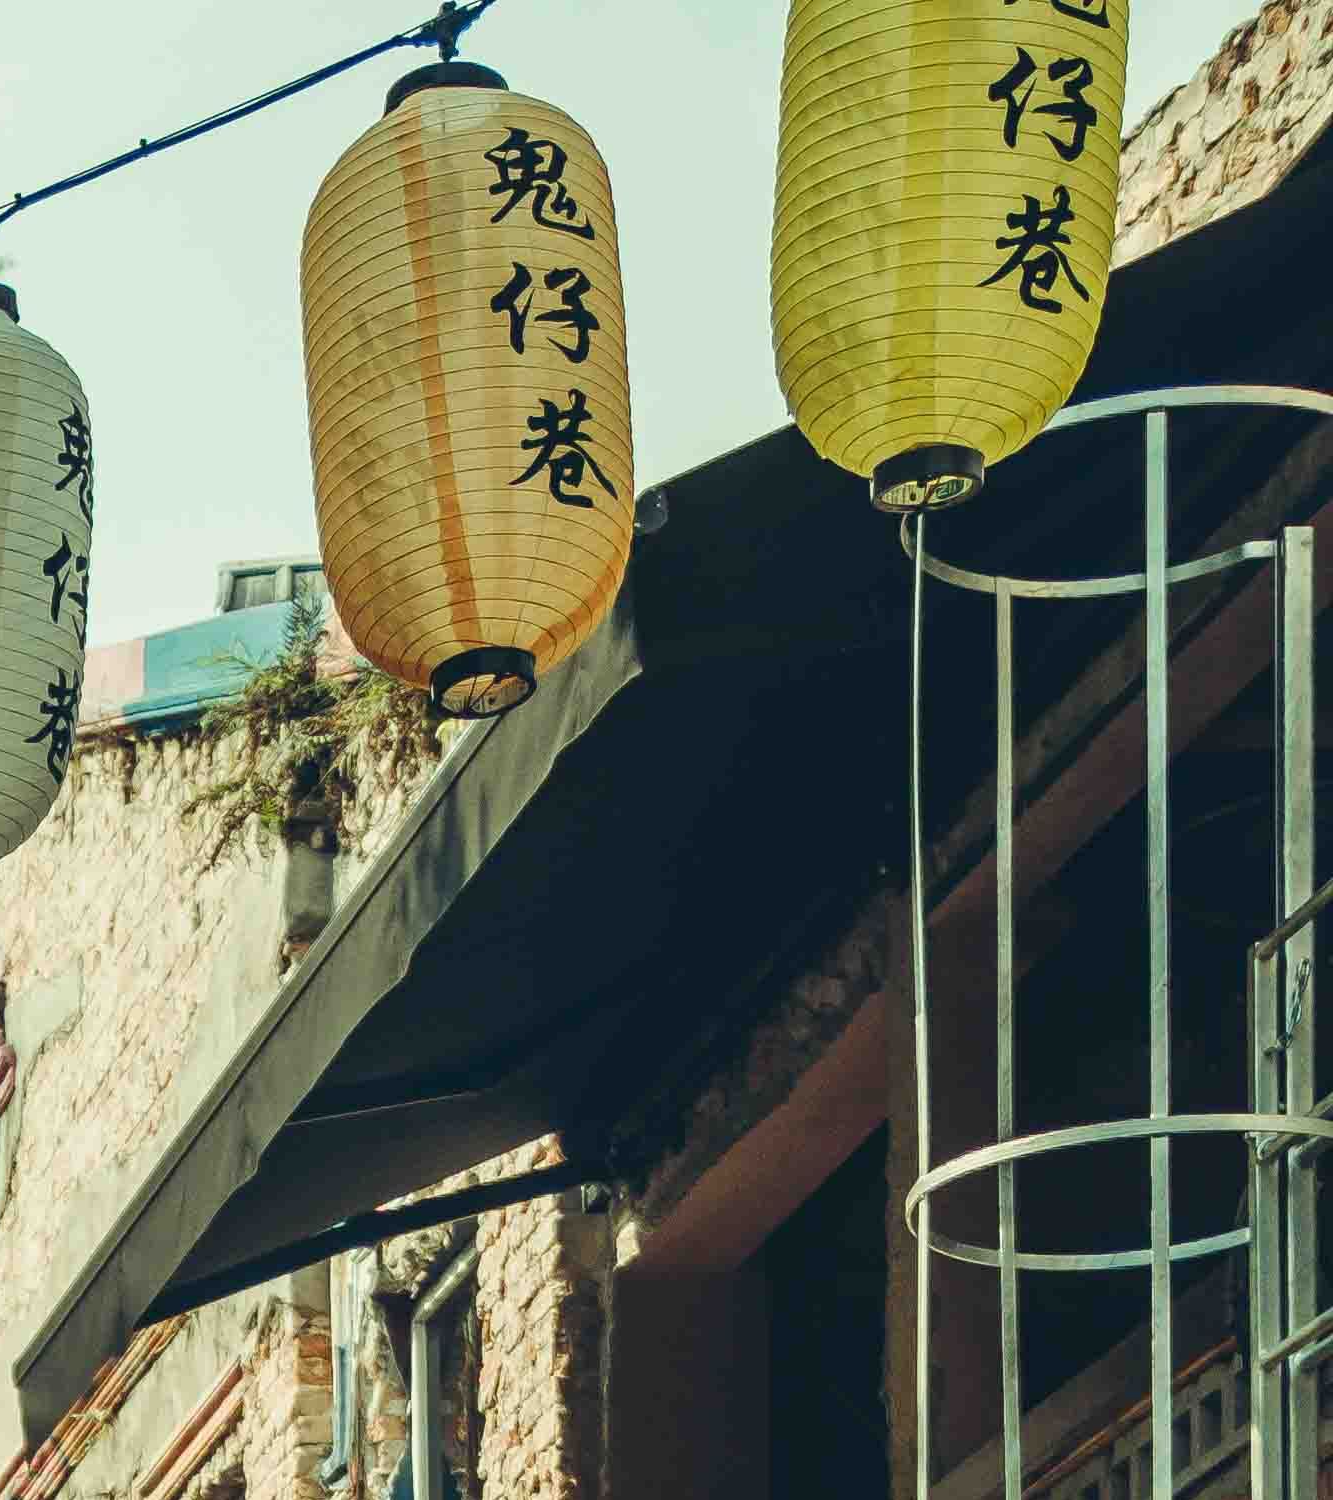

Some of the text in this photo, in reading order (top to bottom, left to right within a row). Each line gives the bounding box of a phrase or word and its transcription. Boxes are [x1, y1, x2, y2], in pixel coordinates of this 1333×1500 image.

[483, 127, 618, 508] 鬼仔巷
[977, 0, 1110, 314] 仔巷
